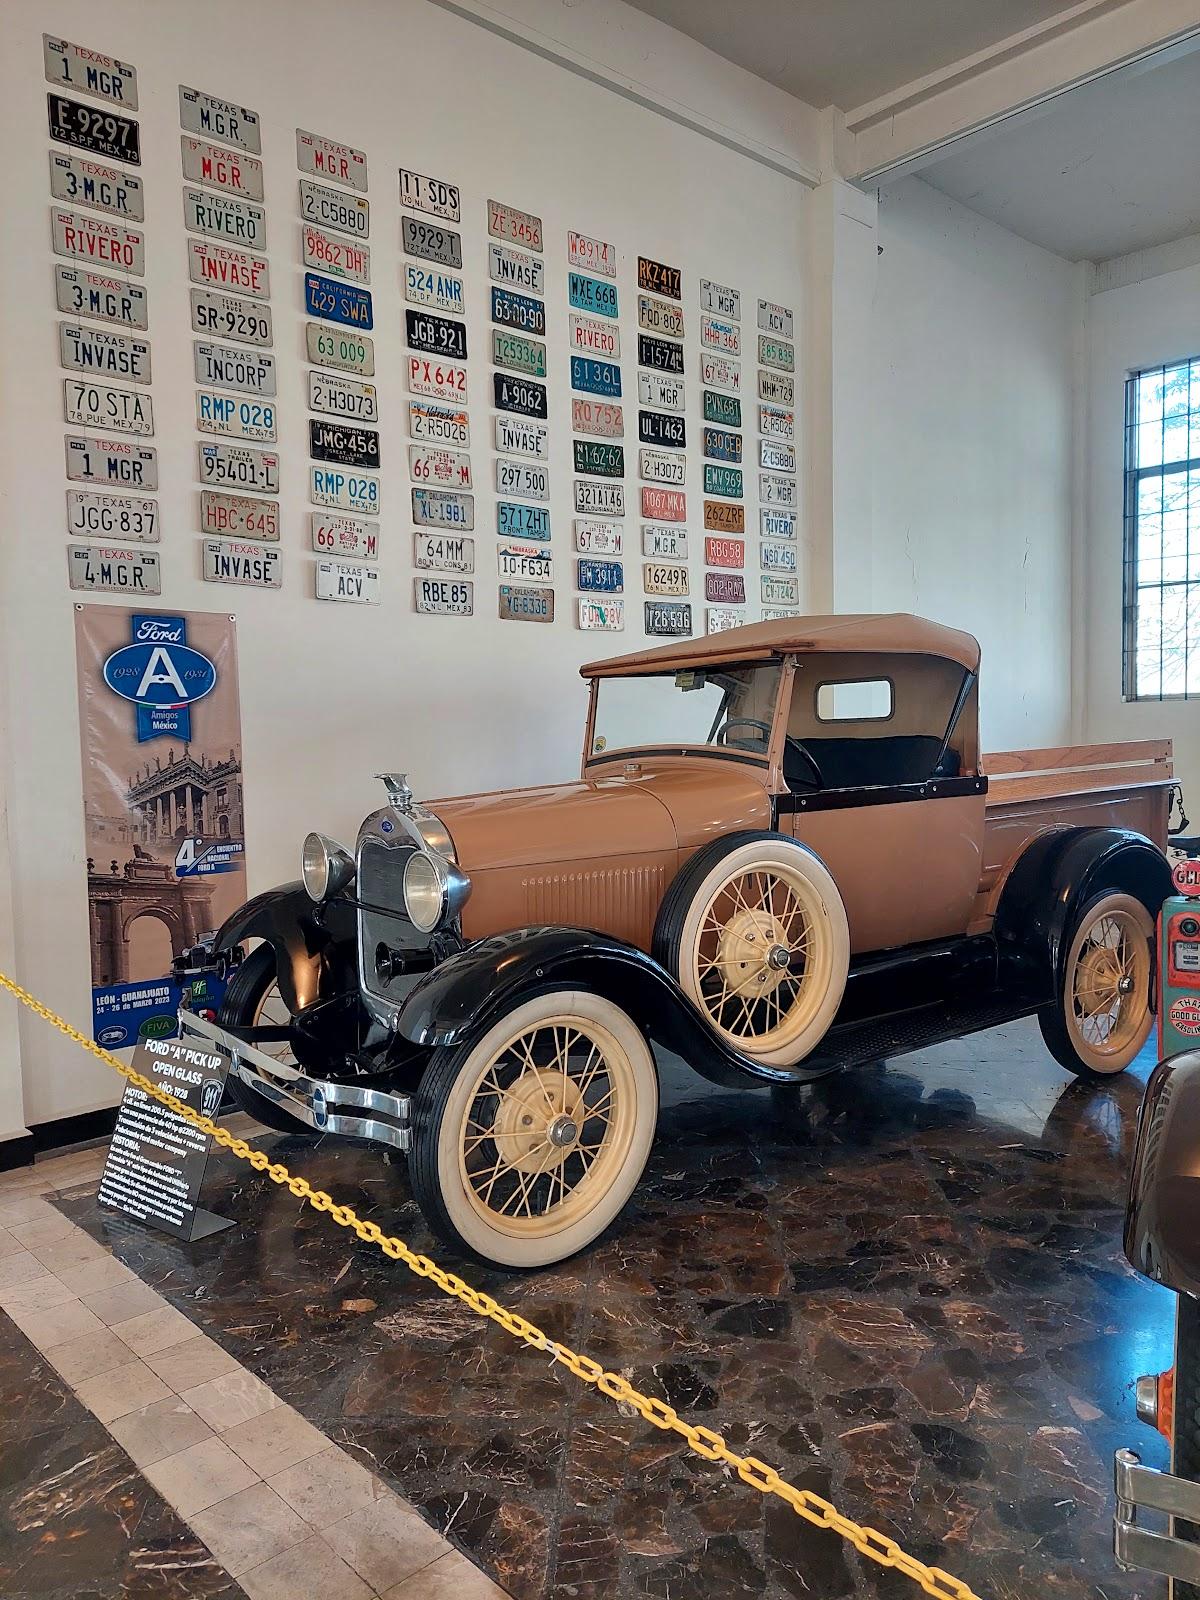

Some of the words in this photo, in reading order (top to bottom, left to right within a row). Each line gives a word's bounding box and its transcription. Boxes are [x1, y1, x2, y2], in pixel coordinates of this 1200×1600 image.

[73, 46, 110, 67] TEXAS
[62, 58, 72, 82] 1
[87, 66, 123, 100] MGR
[203, 96, 237, 116] TEXAS
[53, 126, 66, 138] 72
[126, 150, 138, 160] 73
[319, 139, 347, 156] TEXAS
[207, 147, 240, 164] TEXAS
[80, 162, 117, 180] TEXAS
[308, 185, 343, 201] NEBRASKA
[208, 197, 241, 213] TEXAS
[81, 218, 118, 237] TEXAS
[196, 204, 256, 239] RIVERO
[66, 227, 133, 266] RIVERO
[308, 237, 341, 265] 9862
[346, 250, 361, 272] DH
[213, 248, 246, 264] TEXAS
[508, 250, 528, 264] TEXAS
[200, 256, 260, 289] INVASE
[497, 258, 538, 288] INVASE
[640, 261, 659, 283] RKZ
[660, 268, 679, 289] 417
[87, 275, 121, 291] TEXAS
[408, 268, 433, 293] 524
[437, 276, 461, 302] ANR
[572, 276, 592, 299] WXE
[595, 286, 616, 305] 668
[713, 286, 729, 295] TEXAS
[311, 289, 335, 312] 429
[341, 299, 368, 323] SWA
[653, 302, 670, 312] TEXAS
[719, 296, 735, 314] MGR
[770, 304, 783, 314] TEXAS
[424, 317, 448, 327] TEXAS
[585, 320, 605, 331] TEXAS
[770, 314, 783, 330] ACV
[88, 332, 125, 348] TEXAS
[576, 327, 614, 350] RIVERO
[74, 340, 141, 375] INVASE
[220, 348, 251, 362] TEXAS
[318, 335, 334, 356] 63
[340, 341, 365, 363] 009
[496, 338, 543, 366] T253364
[206, 357, 266, 386] INCORP
[770, 375, 784, 383] TEXAS
[317, 376, 351, 389] NEBRASKA
[653, 377, 671, 386] TEXAS
[74, 386, 99, 412] 70
[107, 392, 144, 421] STA
[660, 387, 678, 404] MGR
[200, 395, 235, 422] RMP
[240, 404, 273, 428] 028
[70, 410, 82, 420] 78
[87, 414, 106, 424] PUE
[114, 419, 133, 429] MEX
[138, 423, 150, 432] 79
[201, 420, 212, 428] 74
[328, 425, 361, 435] MICHIGAN
[513, 422, 534, 432] TEXAS
[96, 441, 131, 454] TEXAS
[503, 429, 542, 453] INVASE
[83, 454, 93, 476] 1
[108, 457, 143, 482] MGR
[415, 459, 430, 477] 66
[315, 470, 344, 495] RMP
[349, 478, 376, 501] 028
[502, 467, 520, 487] 297
[526, 472, 545, 491] 500
[725, 472, 741, 488] 969
[95, 497, 131, 508] TEXAS
[142, 503, 153, 511] 67
[579, 488, 621, 507] 321A146
[646, 492, 665, 508] 1067
[766, 518, 793, 535] RIVERO
[318, 527, 334, 546] 66
[580, 531, 591, 547] 67
[99, 550, 133, 560] TEXAS
[230, 544, 260, 555] TEXAS
[427, 540, 442, 558] 64
[447, 540, 463, 560] MM
[512, 546, 538, 554] NEBRASKA
[710, 540, 727, 557] RBG
[730, 543, 740, 558] 58
[215, 555, 272, 581] INVASE
[337, 566, 362, 576] TEXAS
[338, 577, 362, 597] ACV
[423, 582, 448, 602] RBE
[452, 585, 467, 603] 85
[137, 621, 182, 641] Ford
[113, 667, 140, 678] 1928
[136, 647, 188, 697] A
[151, 711, 178, 720] Amigos
[153, 721, 178, 730] México
[217, 844, 242, 852] ENCUENTRO
[1177, 870, 1200, 885] GUL
[96, 994, 115, 1006] LEÓN
[121, 986, 170, 1002] GUANAJUATO
[112, 1004, 120, 1012] 26
[133, 1000, 152, 1009] MARZO
[155, 996, 170, 1005] 2023
[147, 1021, 170, 1032] FIVA
[1176, 1022, 1200, 1034] GASOLIN
[144, 1039, 169, 1056] FORD
[185, 1050, 208, 1067] PICK
[207, 1056, 221, 1070] UP
[152, 1061, 175, 1077] OPEN
[175, 1068, 203, 1085] GLASS
[125, 1087, 148, 1101] MOTOR:
[158, 1081, 173, 1095] AÑO:
[174, 1086, 188, 1099] 1928
[203, 1087, 218, 1109] 911
[112, 1134, 140, 1152] HISTORIA:
[155, 1128, 182, 1144] velocidades
[195, 1132, 206, 1141] rpm
[165, 1144, 187, 1158] company
